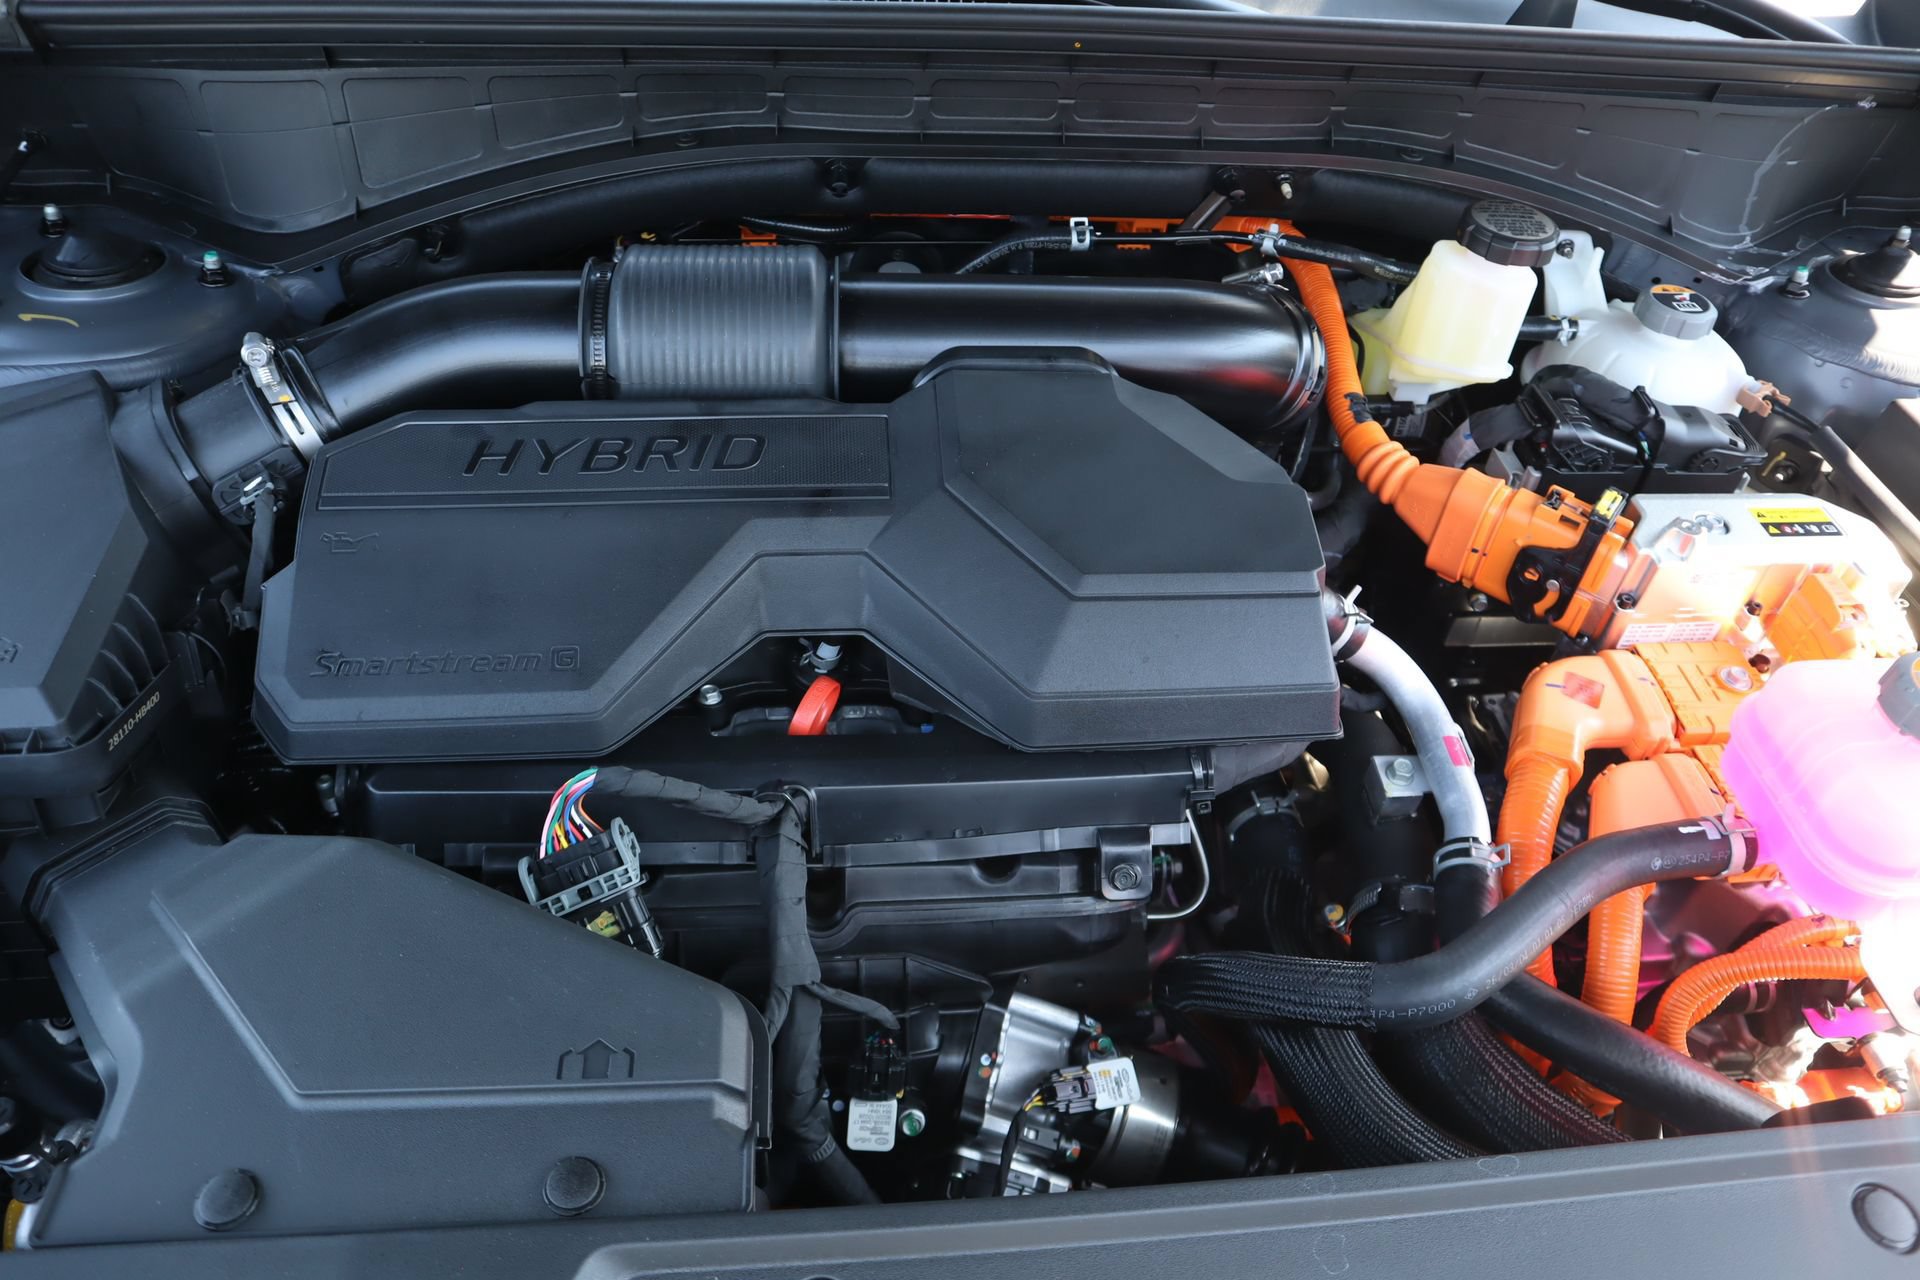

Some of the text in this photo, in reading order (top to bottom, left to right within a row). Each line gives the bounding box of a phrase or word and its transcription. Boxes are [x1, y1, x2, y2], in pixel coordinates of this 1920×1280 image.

[462, 435, 767, 476] HYBRID
[310, 647, 577, 678] Smartstream G
